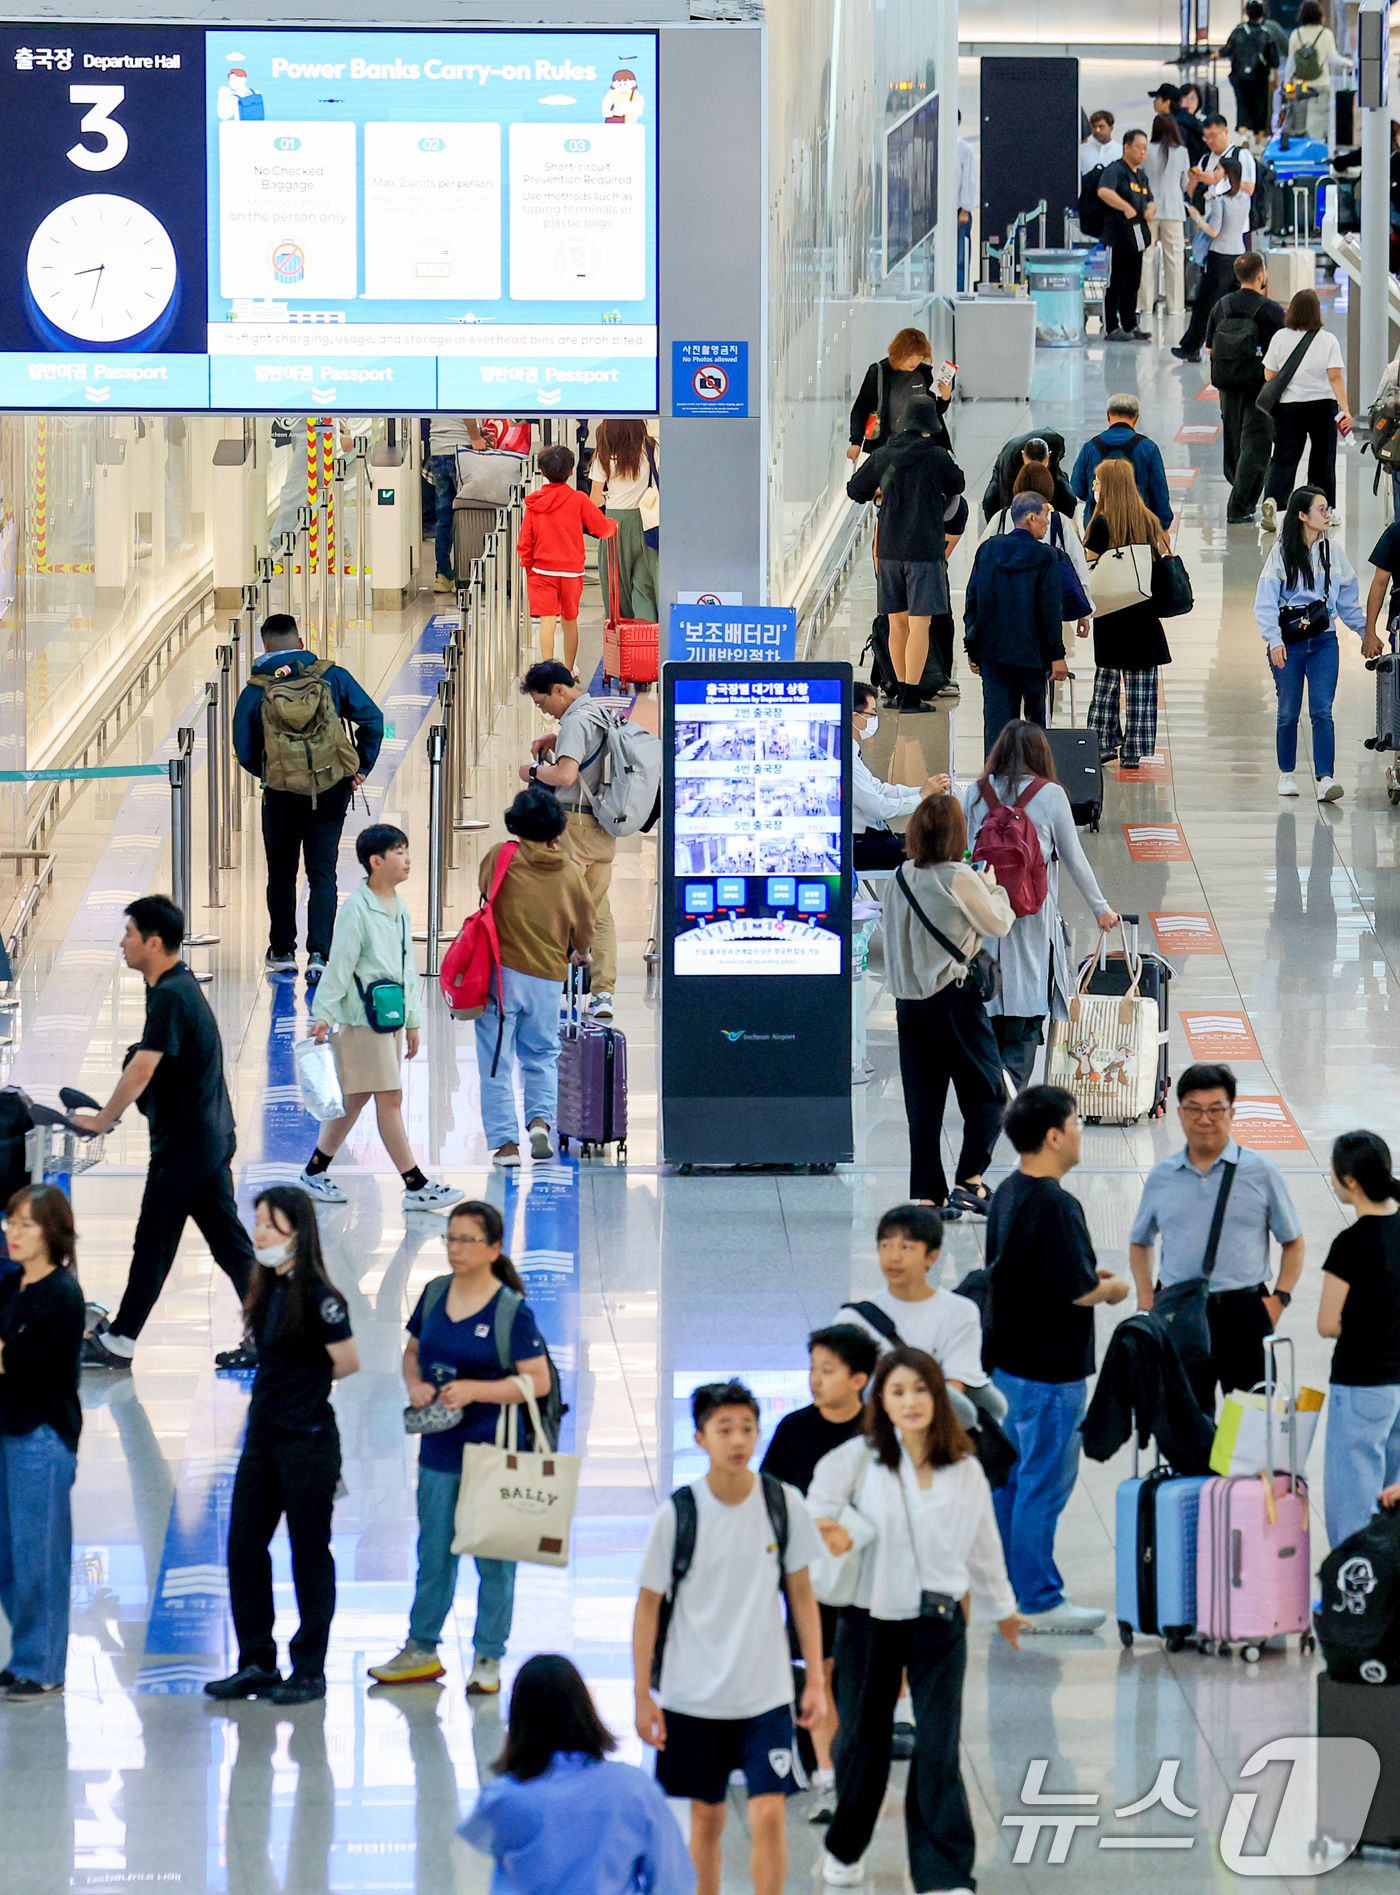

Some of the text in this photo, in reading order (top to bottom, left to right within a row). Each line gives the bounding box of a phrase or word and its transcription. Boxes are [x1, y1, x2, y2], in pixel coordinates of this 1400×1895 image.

[14, 47, 74, 71] 출국장
[83, 54, 181, 71] Departure Hall
[271, 57, 597, 85] Power Banks Carry-on Rules
[65, 84, 129, 172] 3
[280, 138, 295, 149] 01
[423, 139, 440, 151] 02
[568, 140, 586, 152] 03
[254, 166, 324, 176] No Checked
[544, 162, 611, 172] Short-circuit
[261, 179, 314, 193] Baggage
[373, 177, 493, 190] Max 2 units per person
[523, 174, 632, 186] Prevention Required
[522, 192, 633, 201] Use methods such as
[523, 204, 633, 217] taping terminals or
[228, 211, 347, 225] on the person only
[543, 218, 613, 231] plastic bags
[275, 333, 333, 346] charging,
[336, 335, 376, 346] usage,
[379, 334, 401, 344] and
[404, 335, 452, 346] storage
[454, 334, 466, 345] in
[468, 334, 527, 345] overhead
[530, 334, 555, 345] bins
[558, 335, 578, 345] are
[581, 334, 643, 347] prohibited
[27, 363, 168, 382] 일반여권 Passport
[254, 365, 394, 383] 일반여권 Passport
[479, 366, 618, 385] 일반여권 Passport
[706, 682, 809, 695] 출국장별 대기열 상황
[734, 707, 783, 718] 2번 출국장
[734, 764, 783, 775] 4번 출국장
[734, 820, 783, 831] 5번 출국장
[499, 1487, 558, 1506] BALLY
